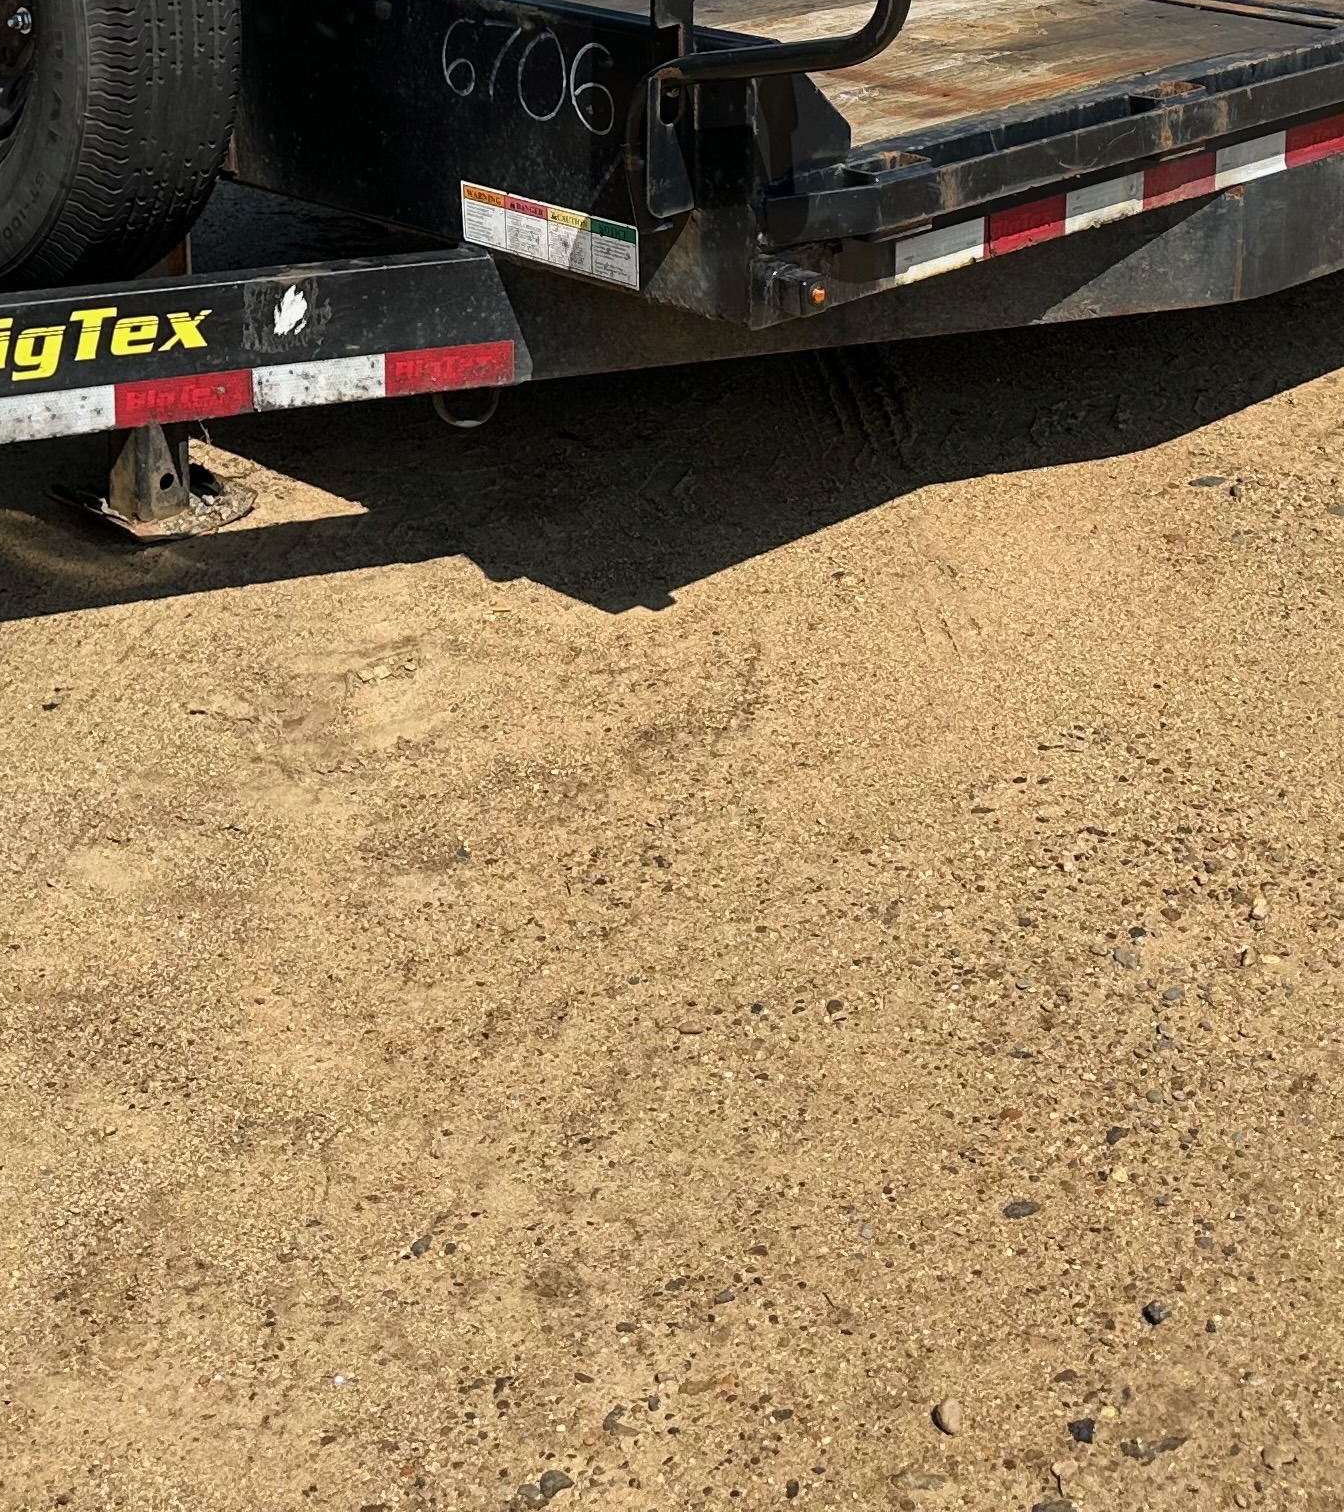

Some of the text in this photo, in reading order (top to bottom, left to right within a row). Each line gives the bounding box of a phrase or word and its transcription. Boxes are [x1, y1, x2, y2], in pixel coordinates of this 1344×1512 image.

[442, 17, 615, 135] 6706
[466, 189, 501, 206] WARNING
[516, 202, 544, 217] DANGER
[557, 213, 588, 228] CAUTION
